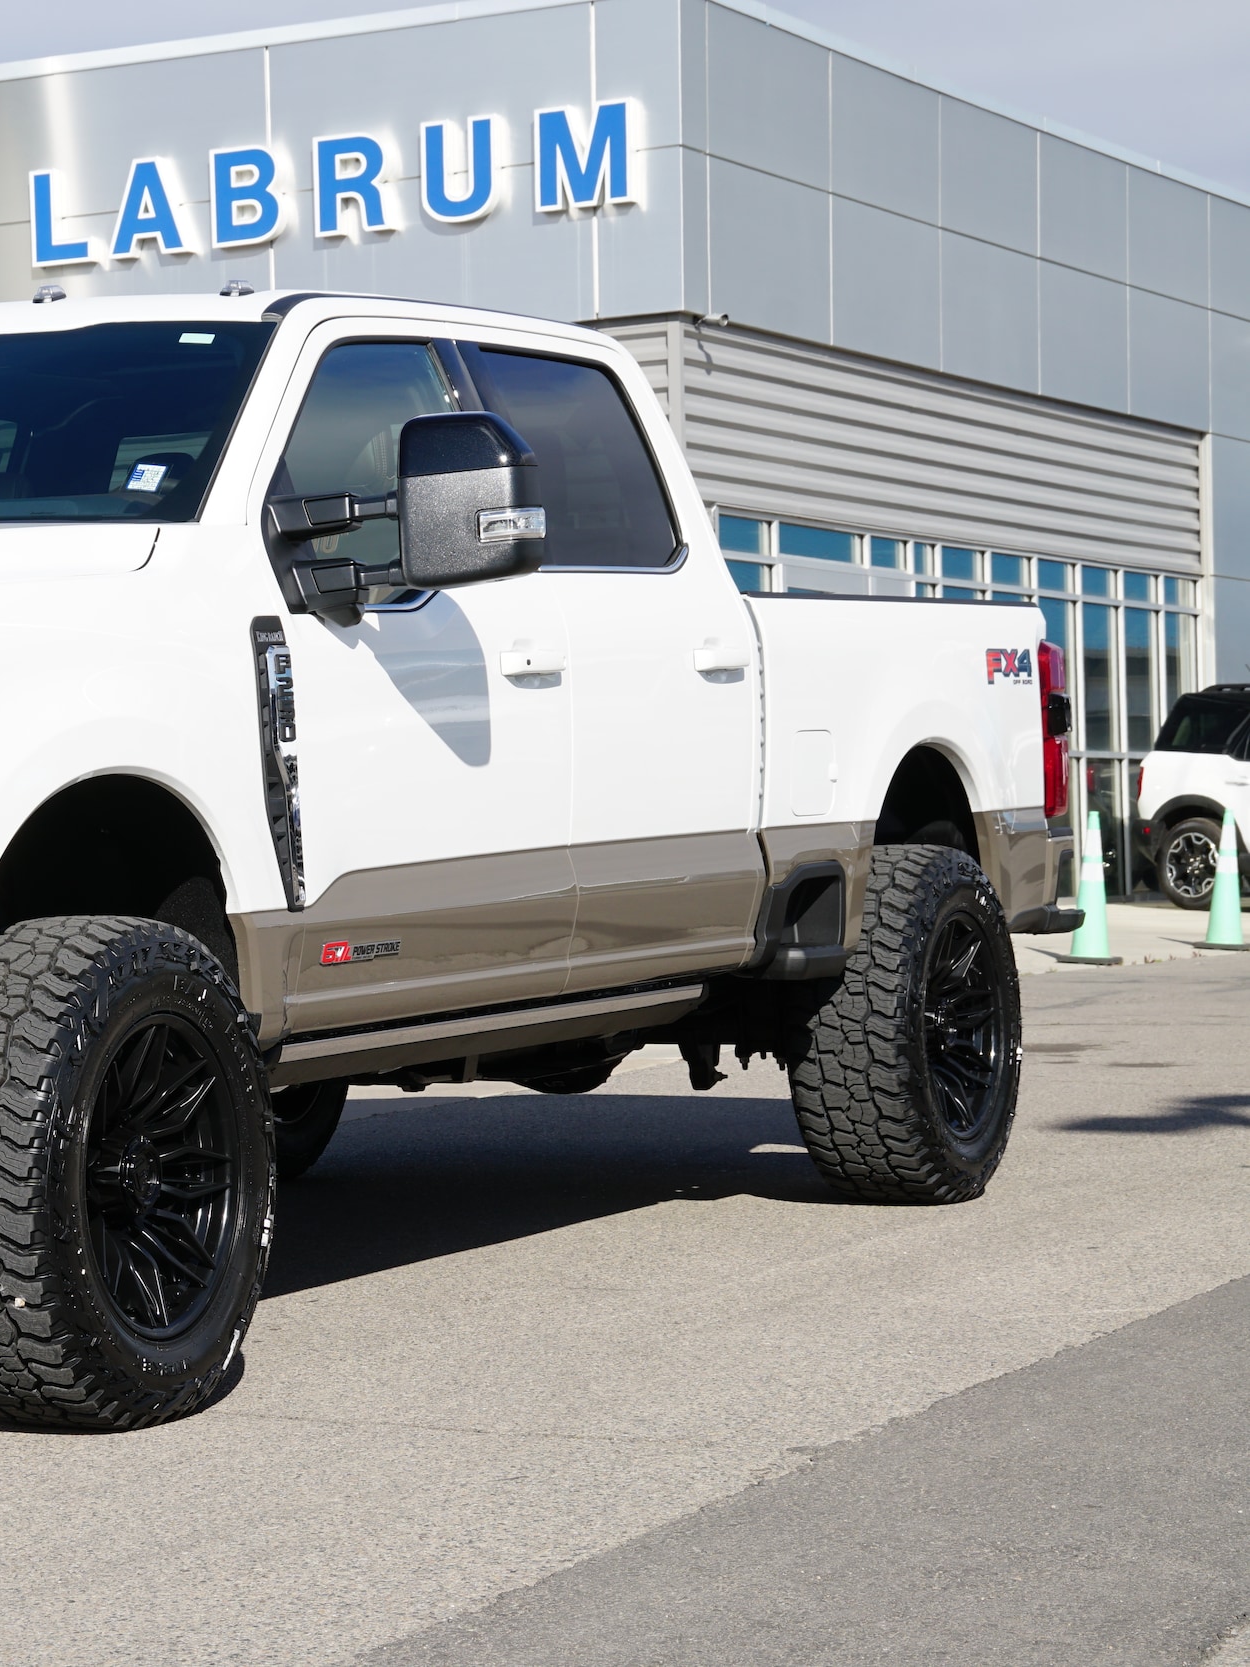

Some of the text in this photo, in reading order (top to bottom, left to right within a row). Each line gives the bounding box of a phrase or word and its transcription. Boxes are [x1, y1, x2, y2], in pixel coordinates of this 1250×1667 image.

[29, 97, 643, 268] LABRUM
[985, 648, 1032, 685] FX4
[352, 944, 375, 957] POWER
[375, 941, 401, 954] STROKE
